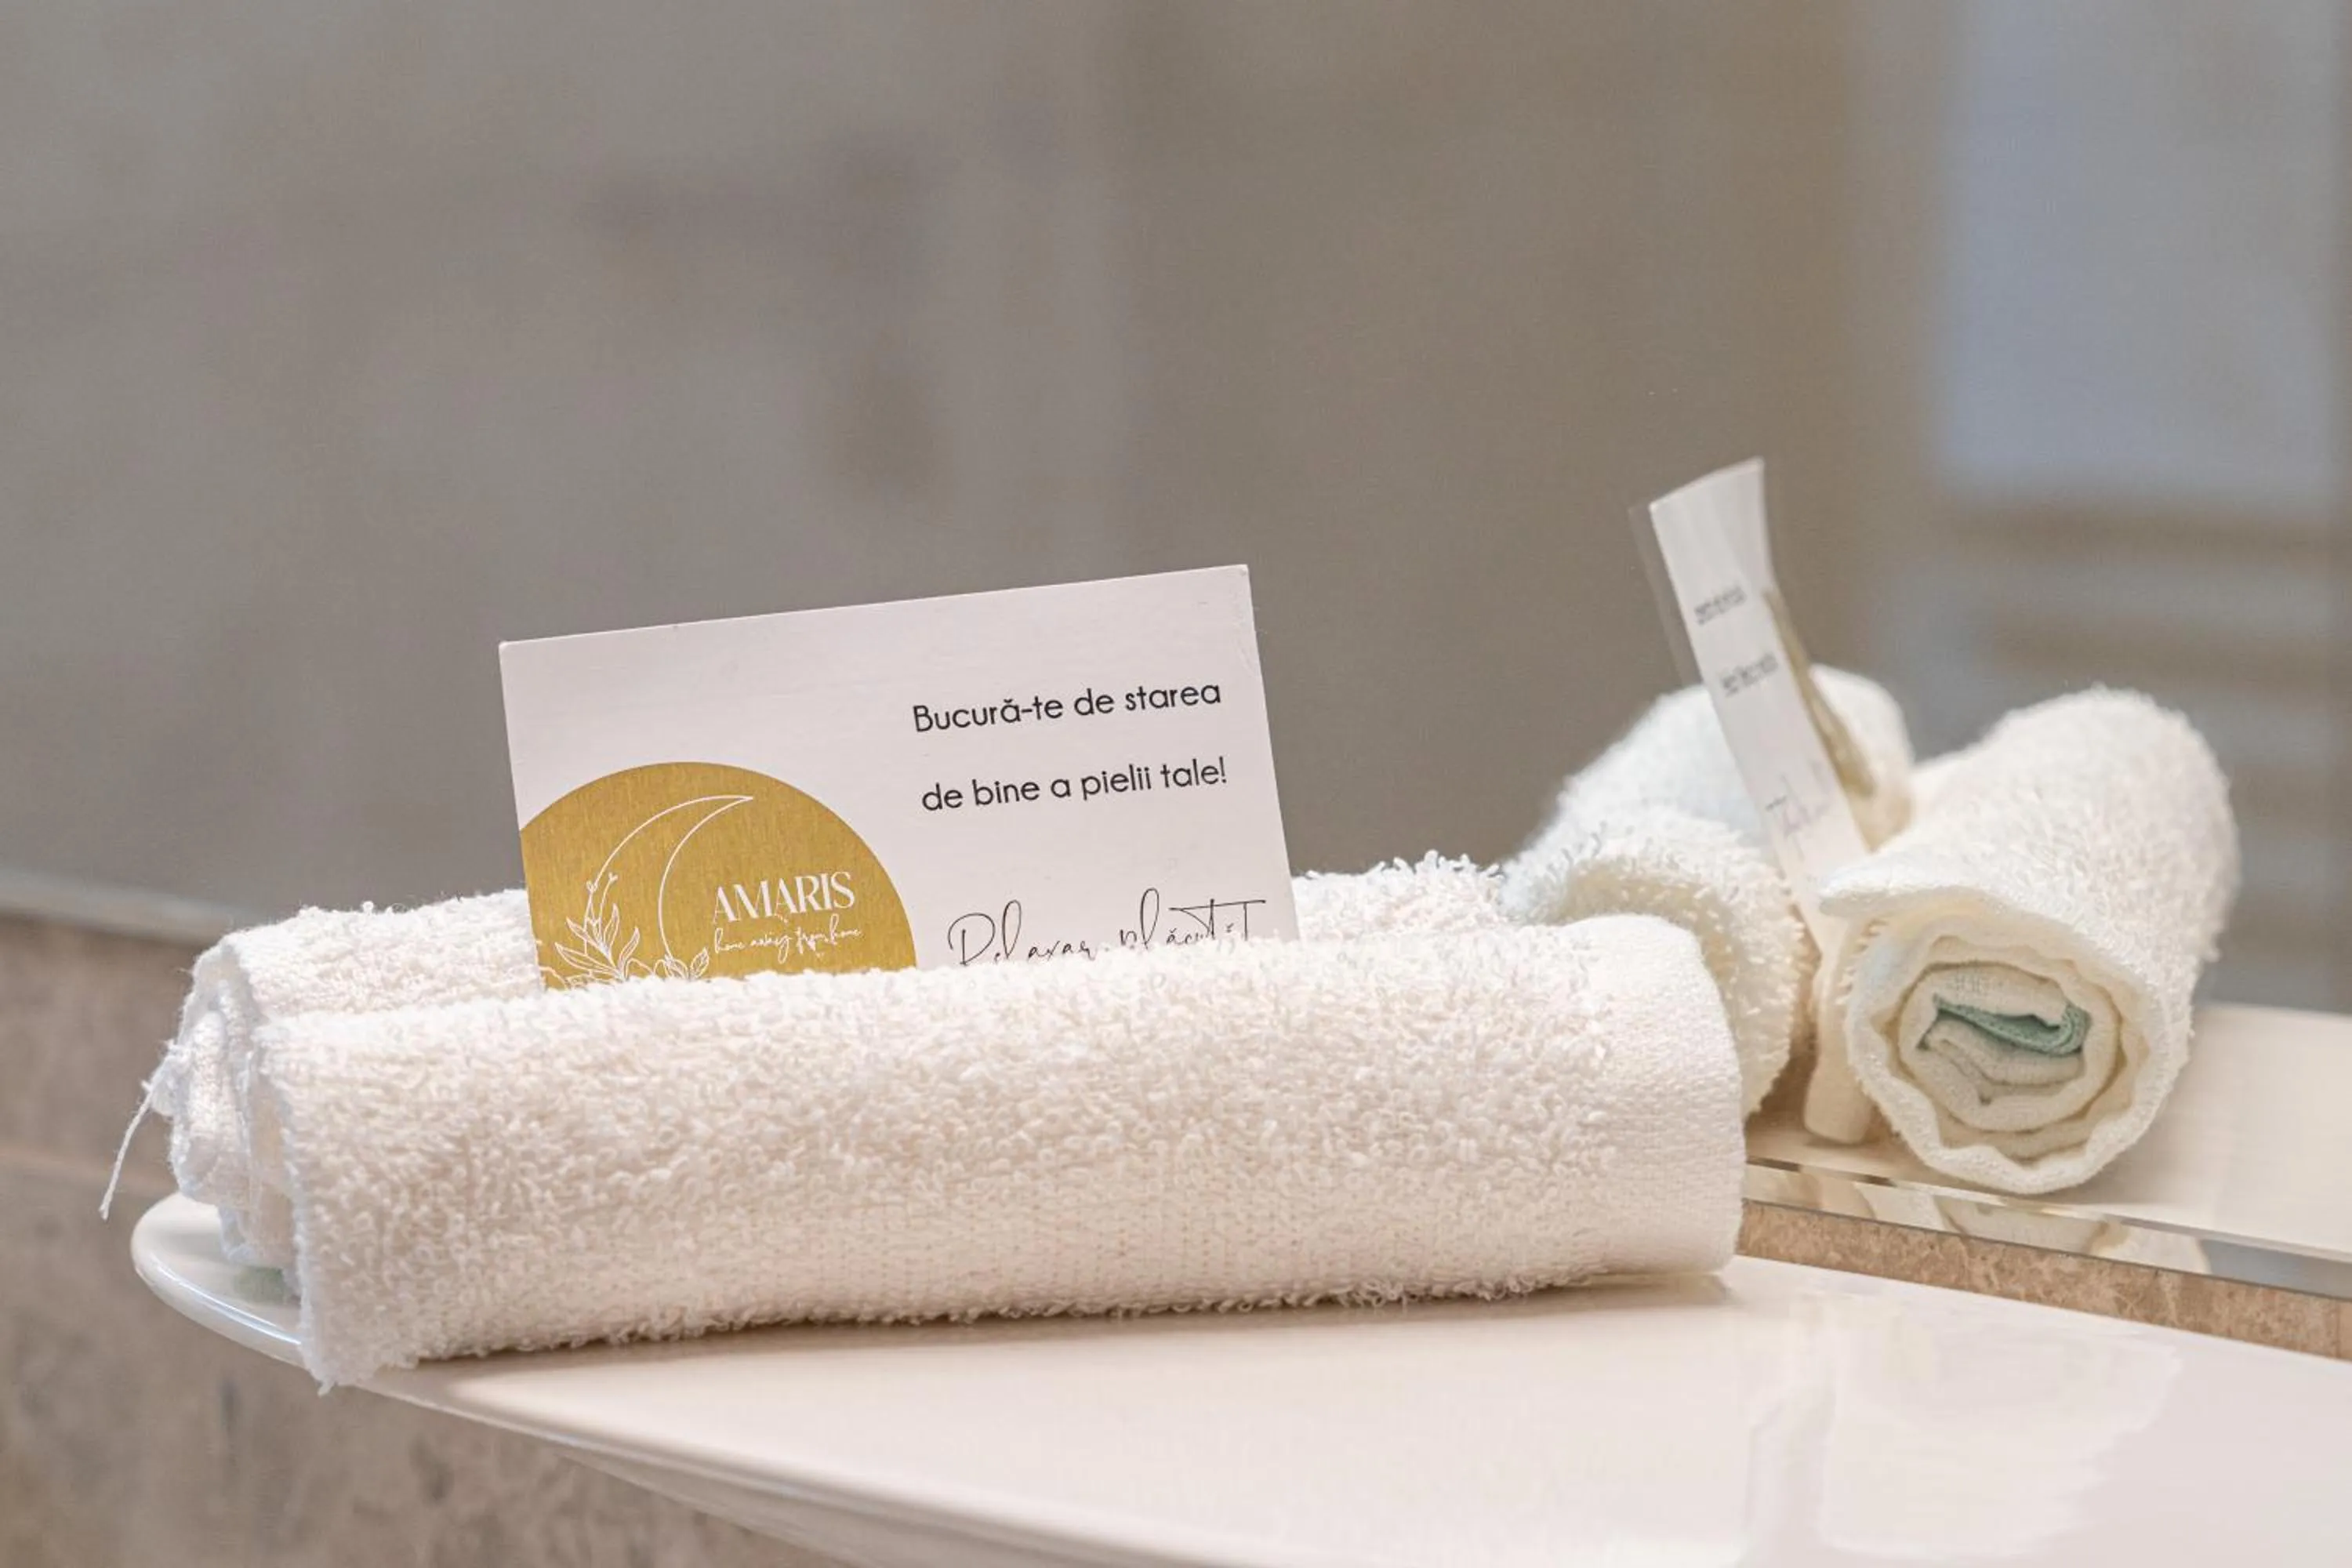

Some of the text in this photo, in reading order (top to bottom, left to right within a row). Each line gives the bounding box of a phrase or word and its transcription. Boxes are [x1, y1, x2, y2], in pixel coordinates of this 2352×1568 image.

[913, 684, 1221, 733] Bucură-te de starea
[921, 755, 1228, 811] de bine a pielii tale!
[712, 871, 855, 924] AMARIS
